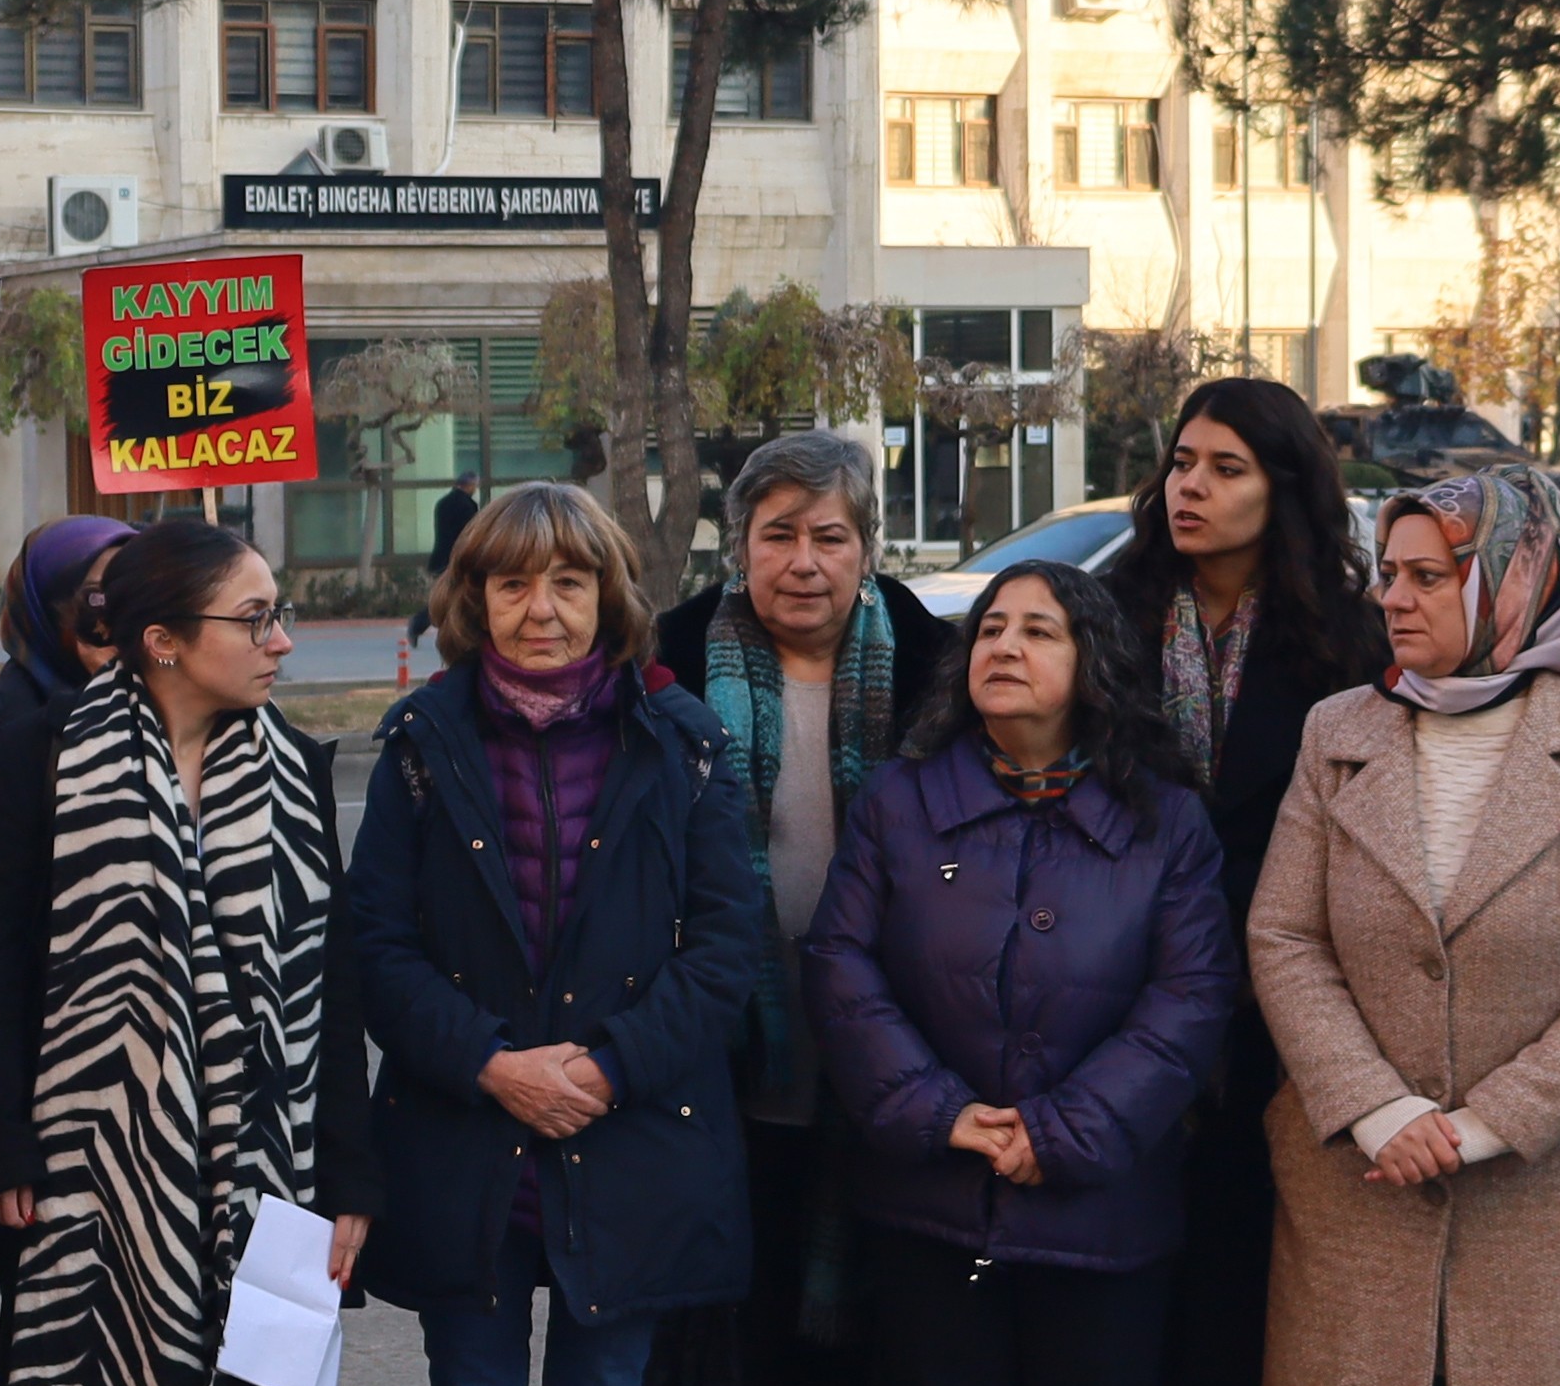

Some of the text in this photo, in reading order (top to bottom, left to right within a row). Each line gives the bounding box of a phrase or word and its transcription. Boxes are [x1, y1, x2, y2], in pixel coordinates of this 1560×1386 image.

[244, 185, 314, 218] EDALET;
[318, 186, 391, 213] BINGEHA
[396, 181, 496, 214] RÊVEBERIYA
[500, 187, 599, 221] ŞAREDARIYA
[112, 275, 274, 321] KAYYIM
[102, 324, 290, 372] GİDECEK
[167, 374, 234, 418] BİZ
[109, 426, 297, 473] KALACAZ
